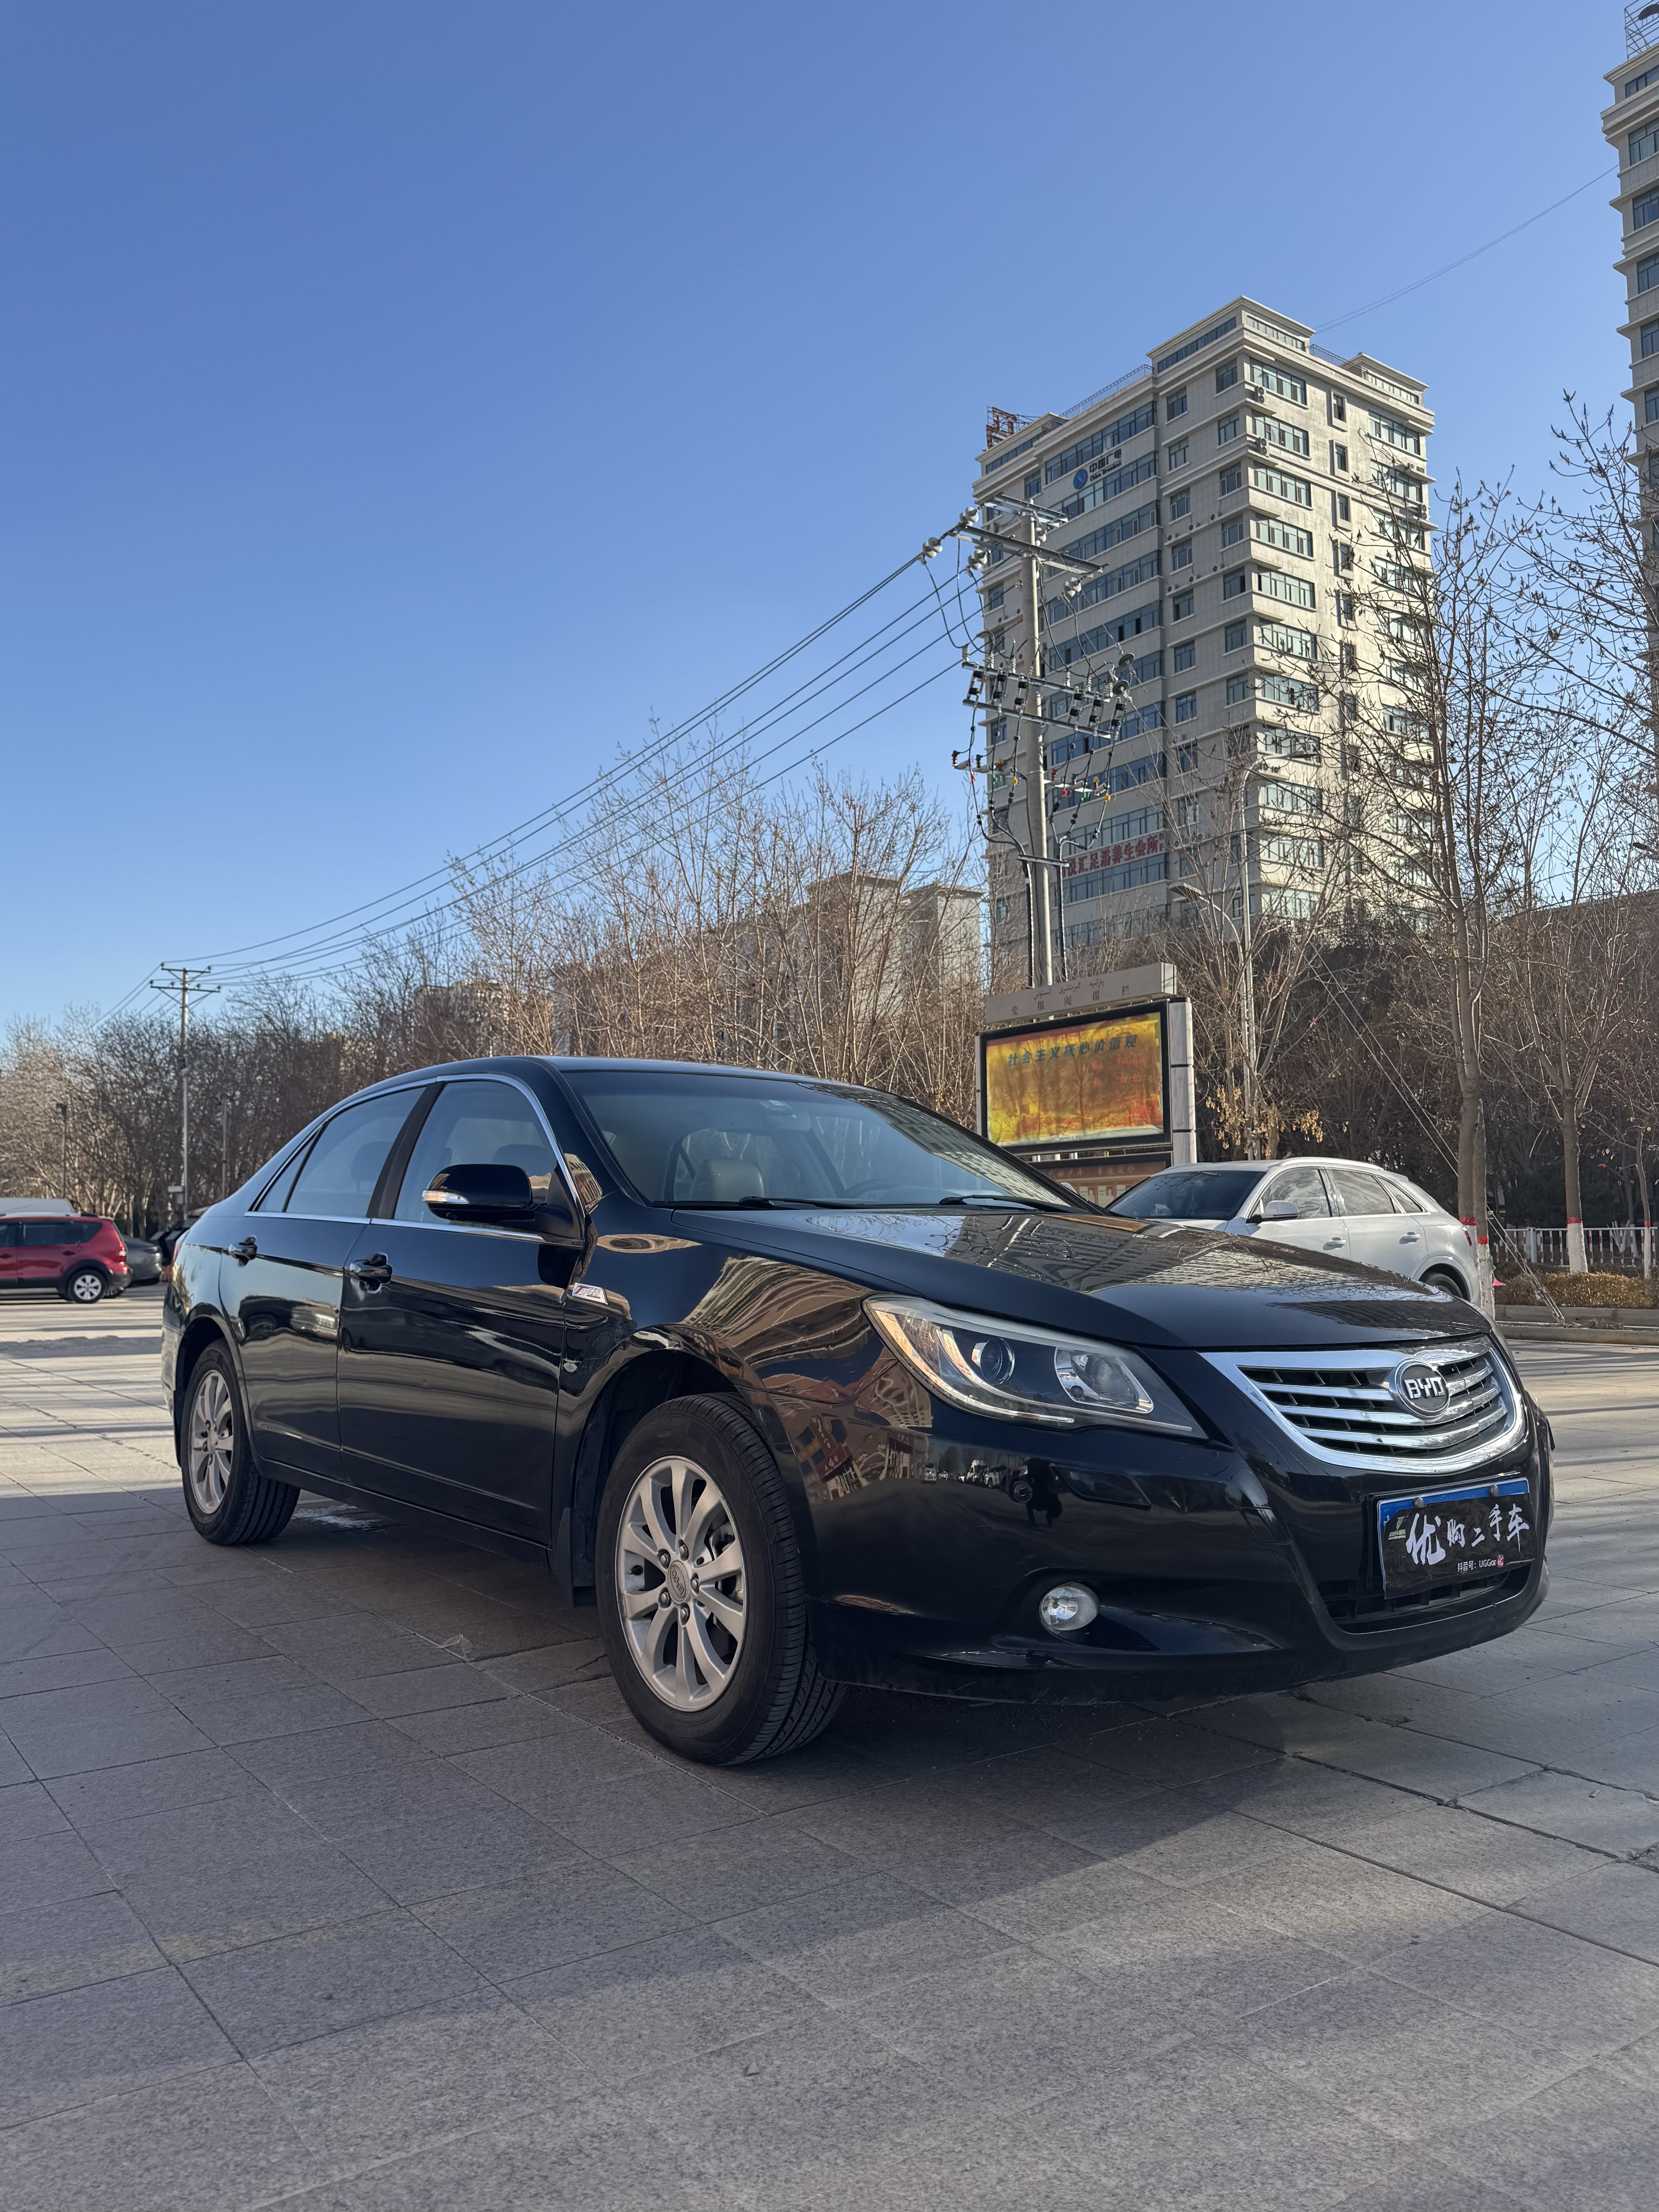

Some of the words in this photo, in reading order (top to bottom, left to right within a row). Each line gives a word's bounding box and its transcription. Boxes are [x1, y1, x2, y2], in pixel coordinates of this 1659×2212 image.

[1089, 449, 1121, 472] 中国广电
[1008, 1035, 1137, 1066] 社会主义核心价值观
[1404, 1377, 1445, 1399] BYD
[1406, 1503, 1529, 1566] 优购二手车
